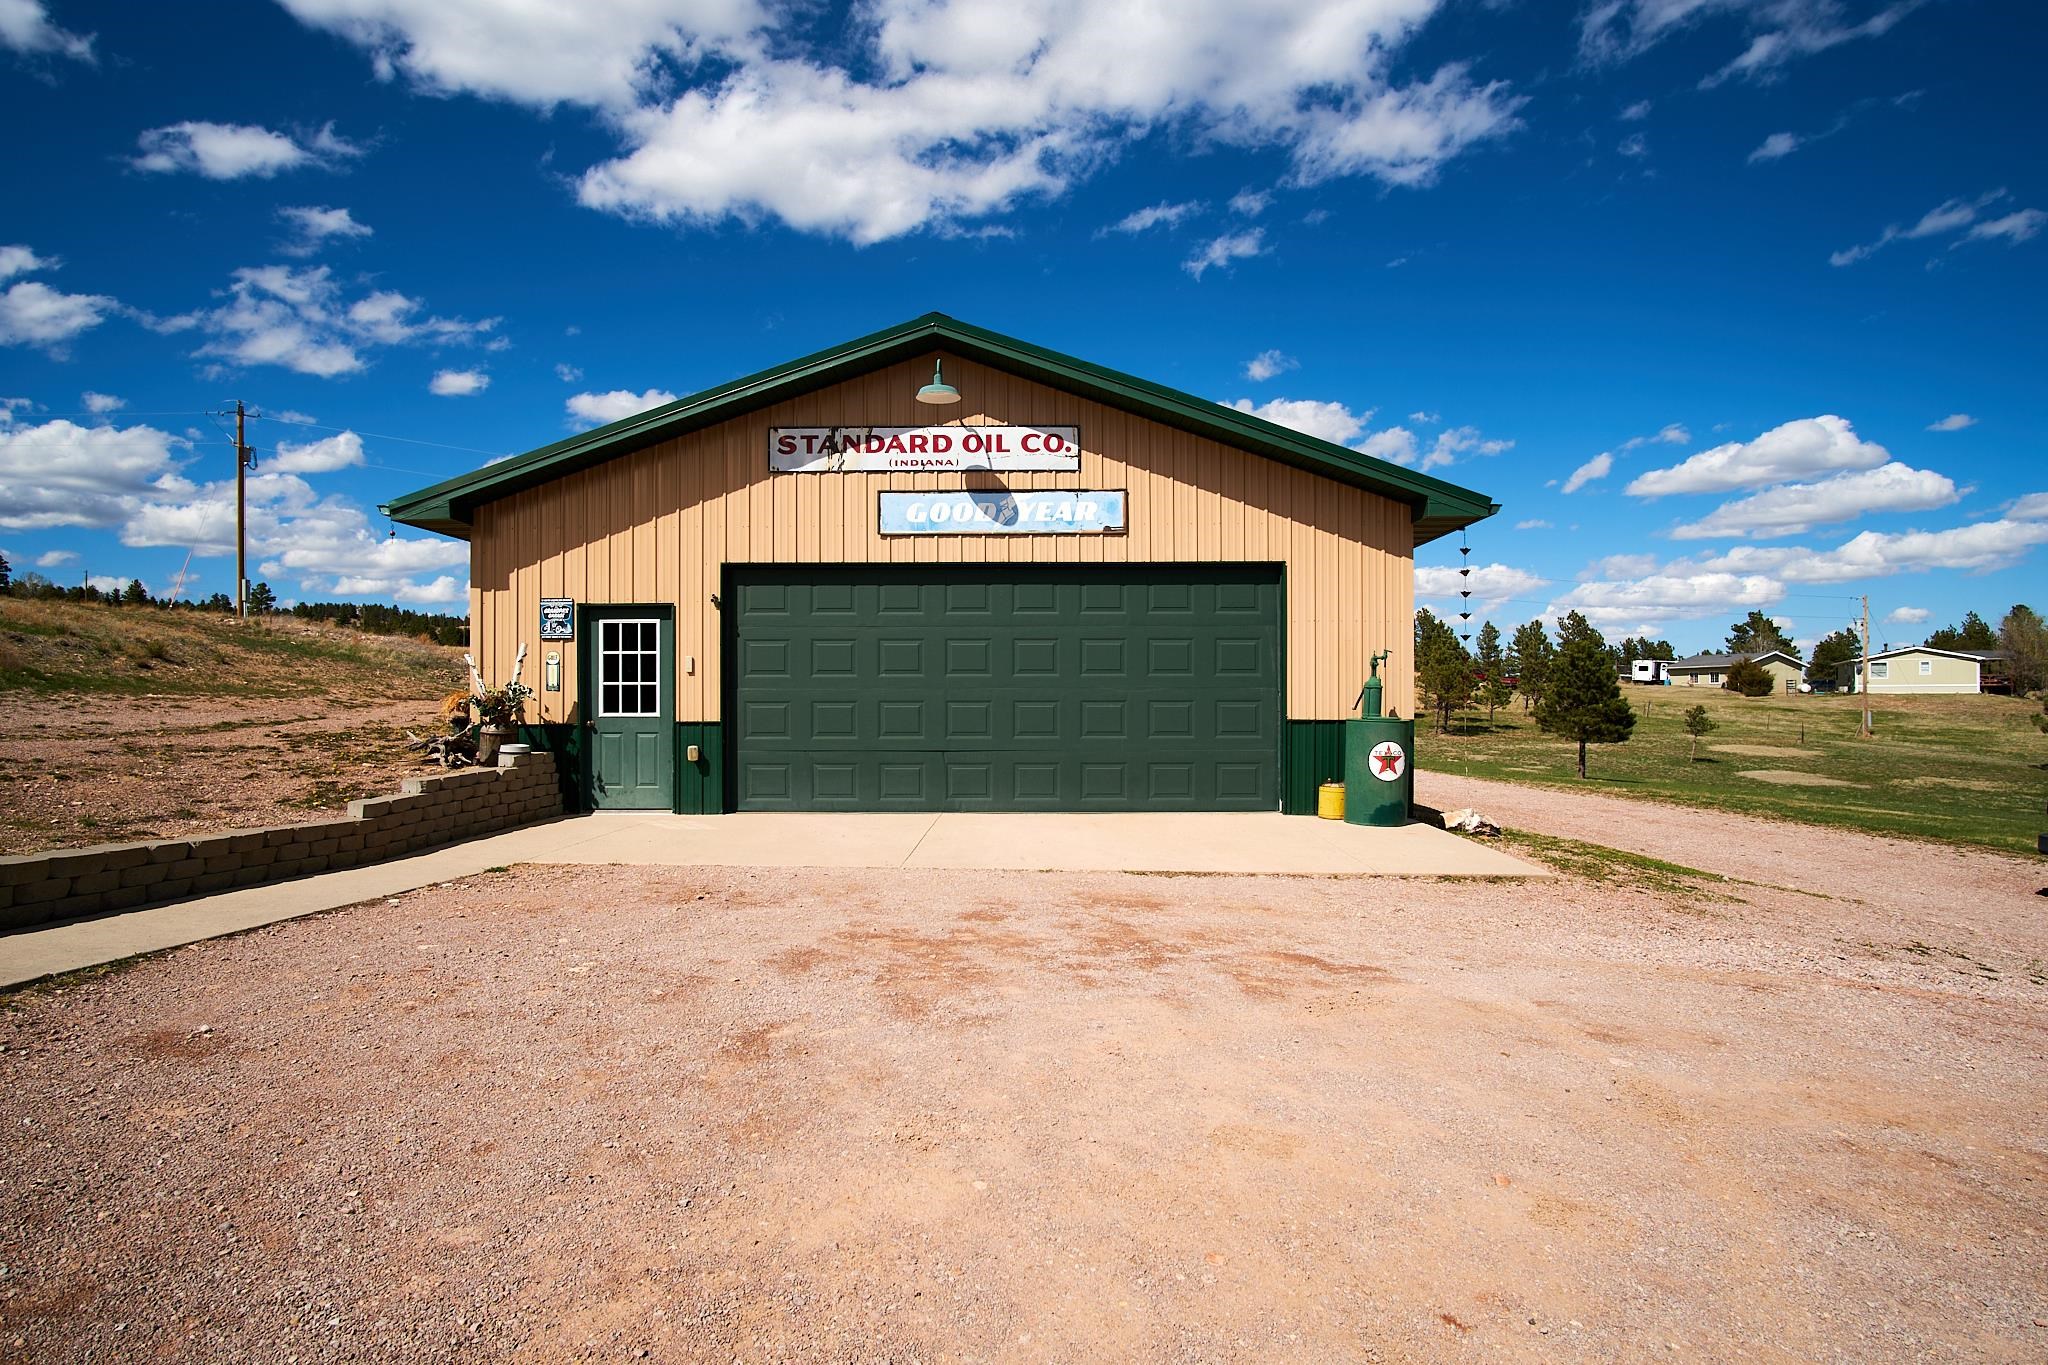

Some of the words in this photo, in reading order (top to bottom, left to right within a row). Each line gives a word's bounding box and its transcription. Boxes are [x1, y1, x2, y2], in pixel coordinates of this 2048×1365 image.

[777, 434, 952, 455] STANDARD
[962, 433, 1011, 453] OIL
[1020, 433, 1072, 453] CO.
[888, 459, 959, 468] (INDIANA)
